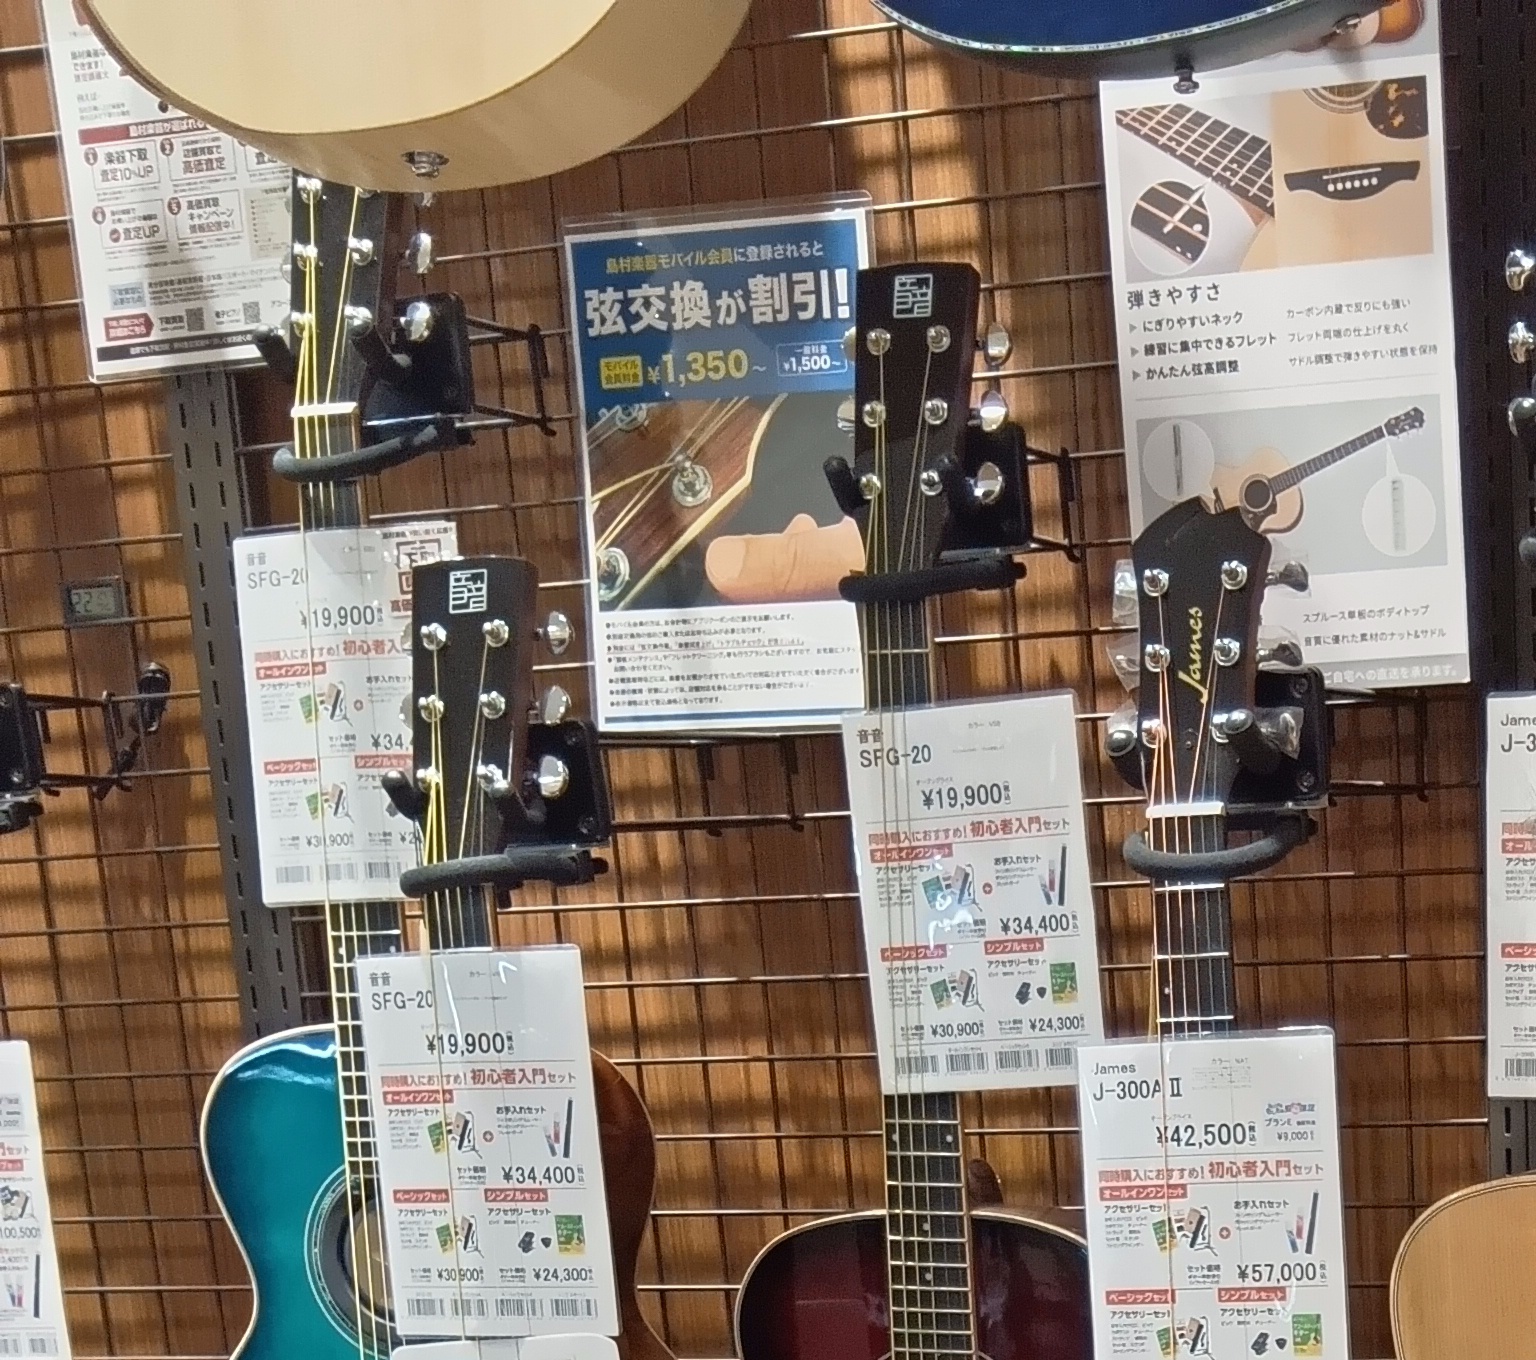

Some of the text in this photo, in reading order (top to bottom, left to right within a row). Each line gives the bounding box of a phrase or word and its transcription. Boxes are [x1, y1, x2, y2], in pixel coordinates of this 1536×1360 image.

[104, 148, 149, 164] 楽器下取
[182, 157, 226, 174] 高価査定
[188, 208, 234, 221] キャンペーン
[123, 226, 160, 240] 査定UP
[606, 240, 824, 274] 島村楽器モバイル会員に登録されると
[584, 268, 850, 338] 弦交換が割引!
[1127, 283, 1222, 310] 弾きやすさ
[1286, 298, 1411, 320] カーボン内蔵で反りにも強い
[1142, 311, 1244, 334] にぎりやすいネック
[1143, 332, 1278, 357] 練習に集中できるフレット
[604, 360, 638, 371] モバイル
[1146, 359, 1240, 381] かんたん弦高調整
[605, 372, 640, 384] 会員料金
[255, 639, 400, 662] 同時購入におすすめ!初心者入
[1178, 606, 1209, 705] James
[371, 733, 413, 750] ¥34,
[857, 728, 883, 744] 音音
[860, 744, 931, 768] SFG-20
[921, 783, 1002, 810] ¥19,900
[993, 855, 1042, 866] お手入れセット
[1000, 913, 1070, 936] ¥34,400
[986, 941, 1042, 953] シンプルセット
[370, 972, 391, 986] 音音
[372, 990, 433, 1010] SFG-20
[930, 1022, 980, 1039] ¥30,900
[1028, 1016, 1079, 1033] ¥24,300
[426, 1032, 505, 1056] ¥19,900
[1093, 1063, 1137, 1075] James
[1093, 1079, 1161, 1102] J-300A
[496, 1106, 546, 1115] お手入れセット
[1157, 1122, 1247, 1149] ¥42,500
[502, 1166, 575, 1185] ¥34,400
[1099, 1160, 1324, 1183] 同時購入におすすめ!初心者入門セット
[396, 1192, 447, 1201] ベーシックセット
[487, 1190, 546, 1201] シンプルセット
[487, 1208, 551, 1217] アクセサリーセット
[1234, 1199, 1289, 1210] お手入れセット
[437, 1268, 480, 1283] ¥30900
[533, 1267, 588, 1282] ¥24,300
[1237, 1262, 1317, 1284] ¥57,000
